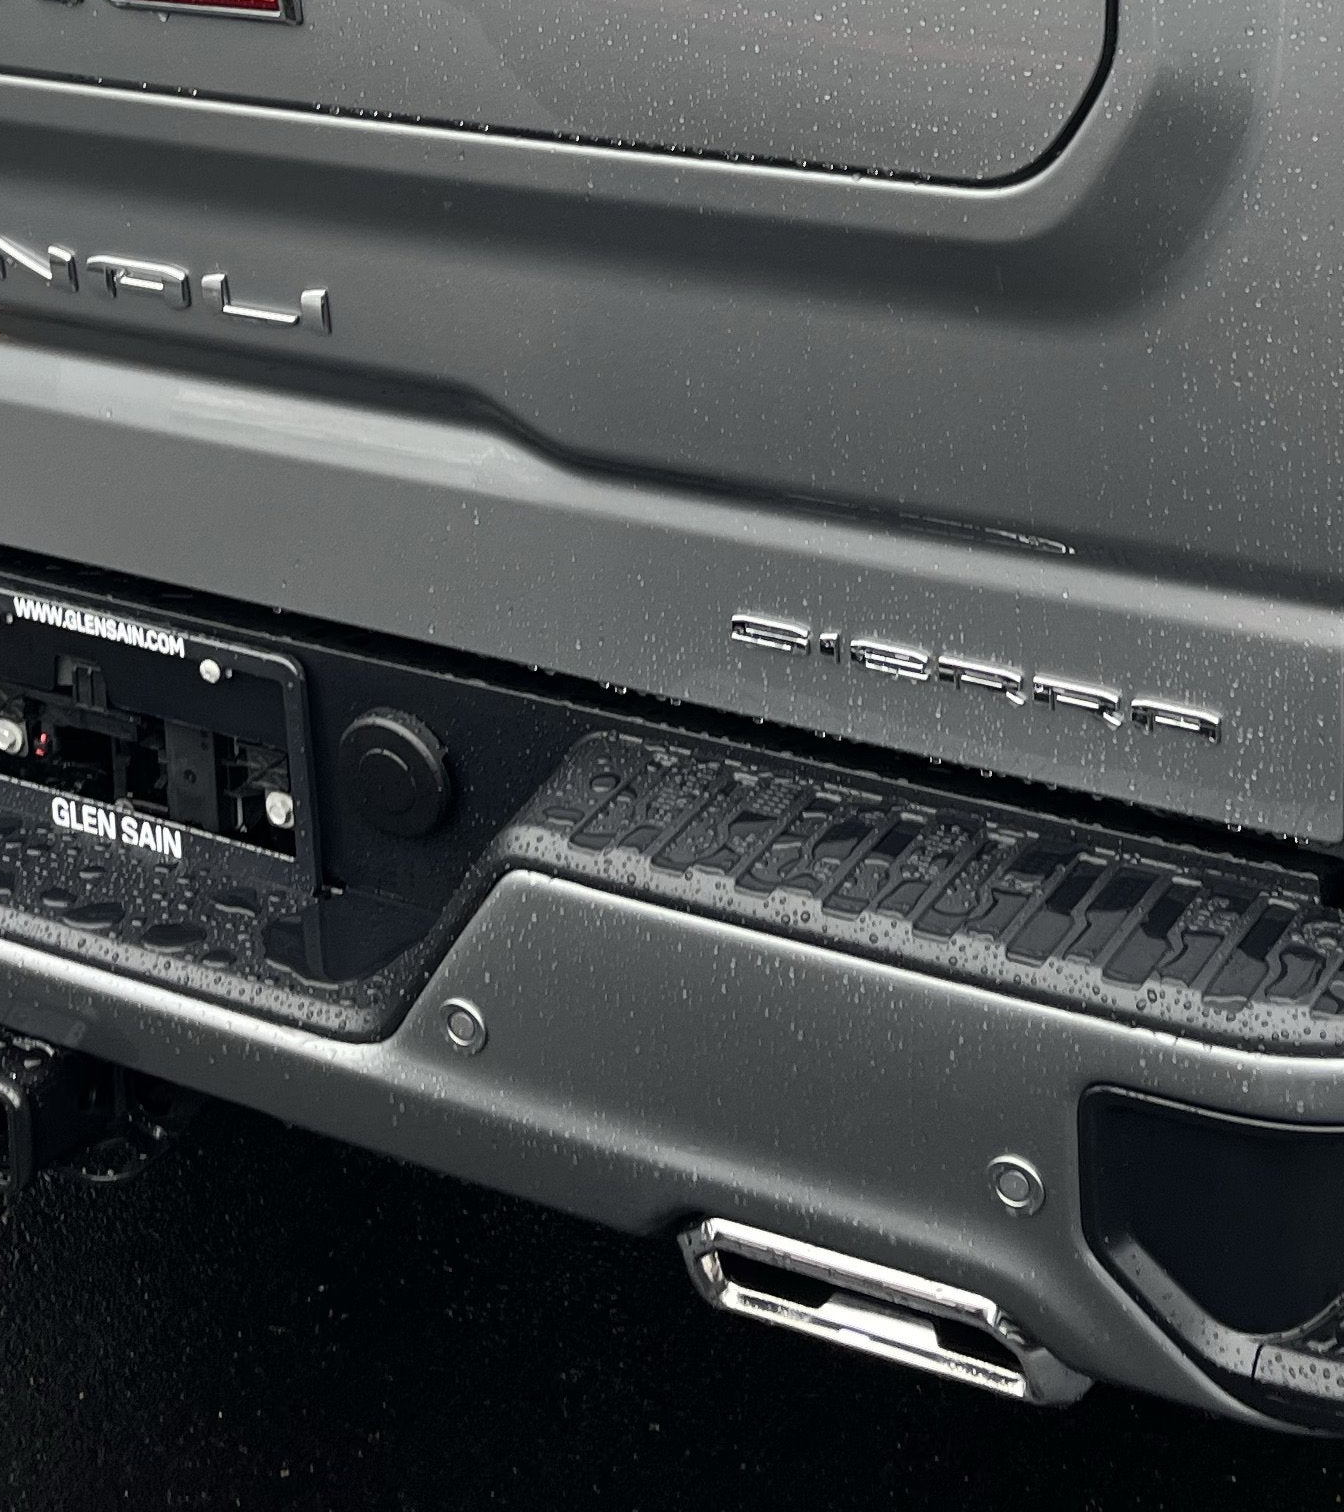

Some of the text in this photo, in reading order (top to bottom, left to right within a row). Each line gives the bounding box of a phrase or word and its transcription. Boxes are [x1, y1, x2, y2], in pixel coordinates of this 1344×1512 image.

[12, 595, 185, 659] WWW.GLENSAIN.COM
[730, 613, 1222, 744] SIERRA
[51, 795, 182, 859] GLEN SAIN
